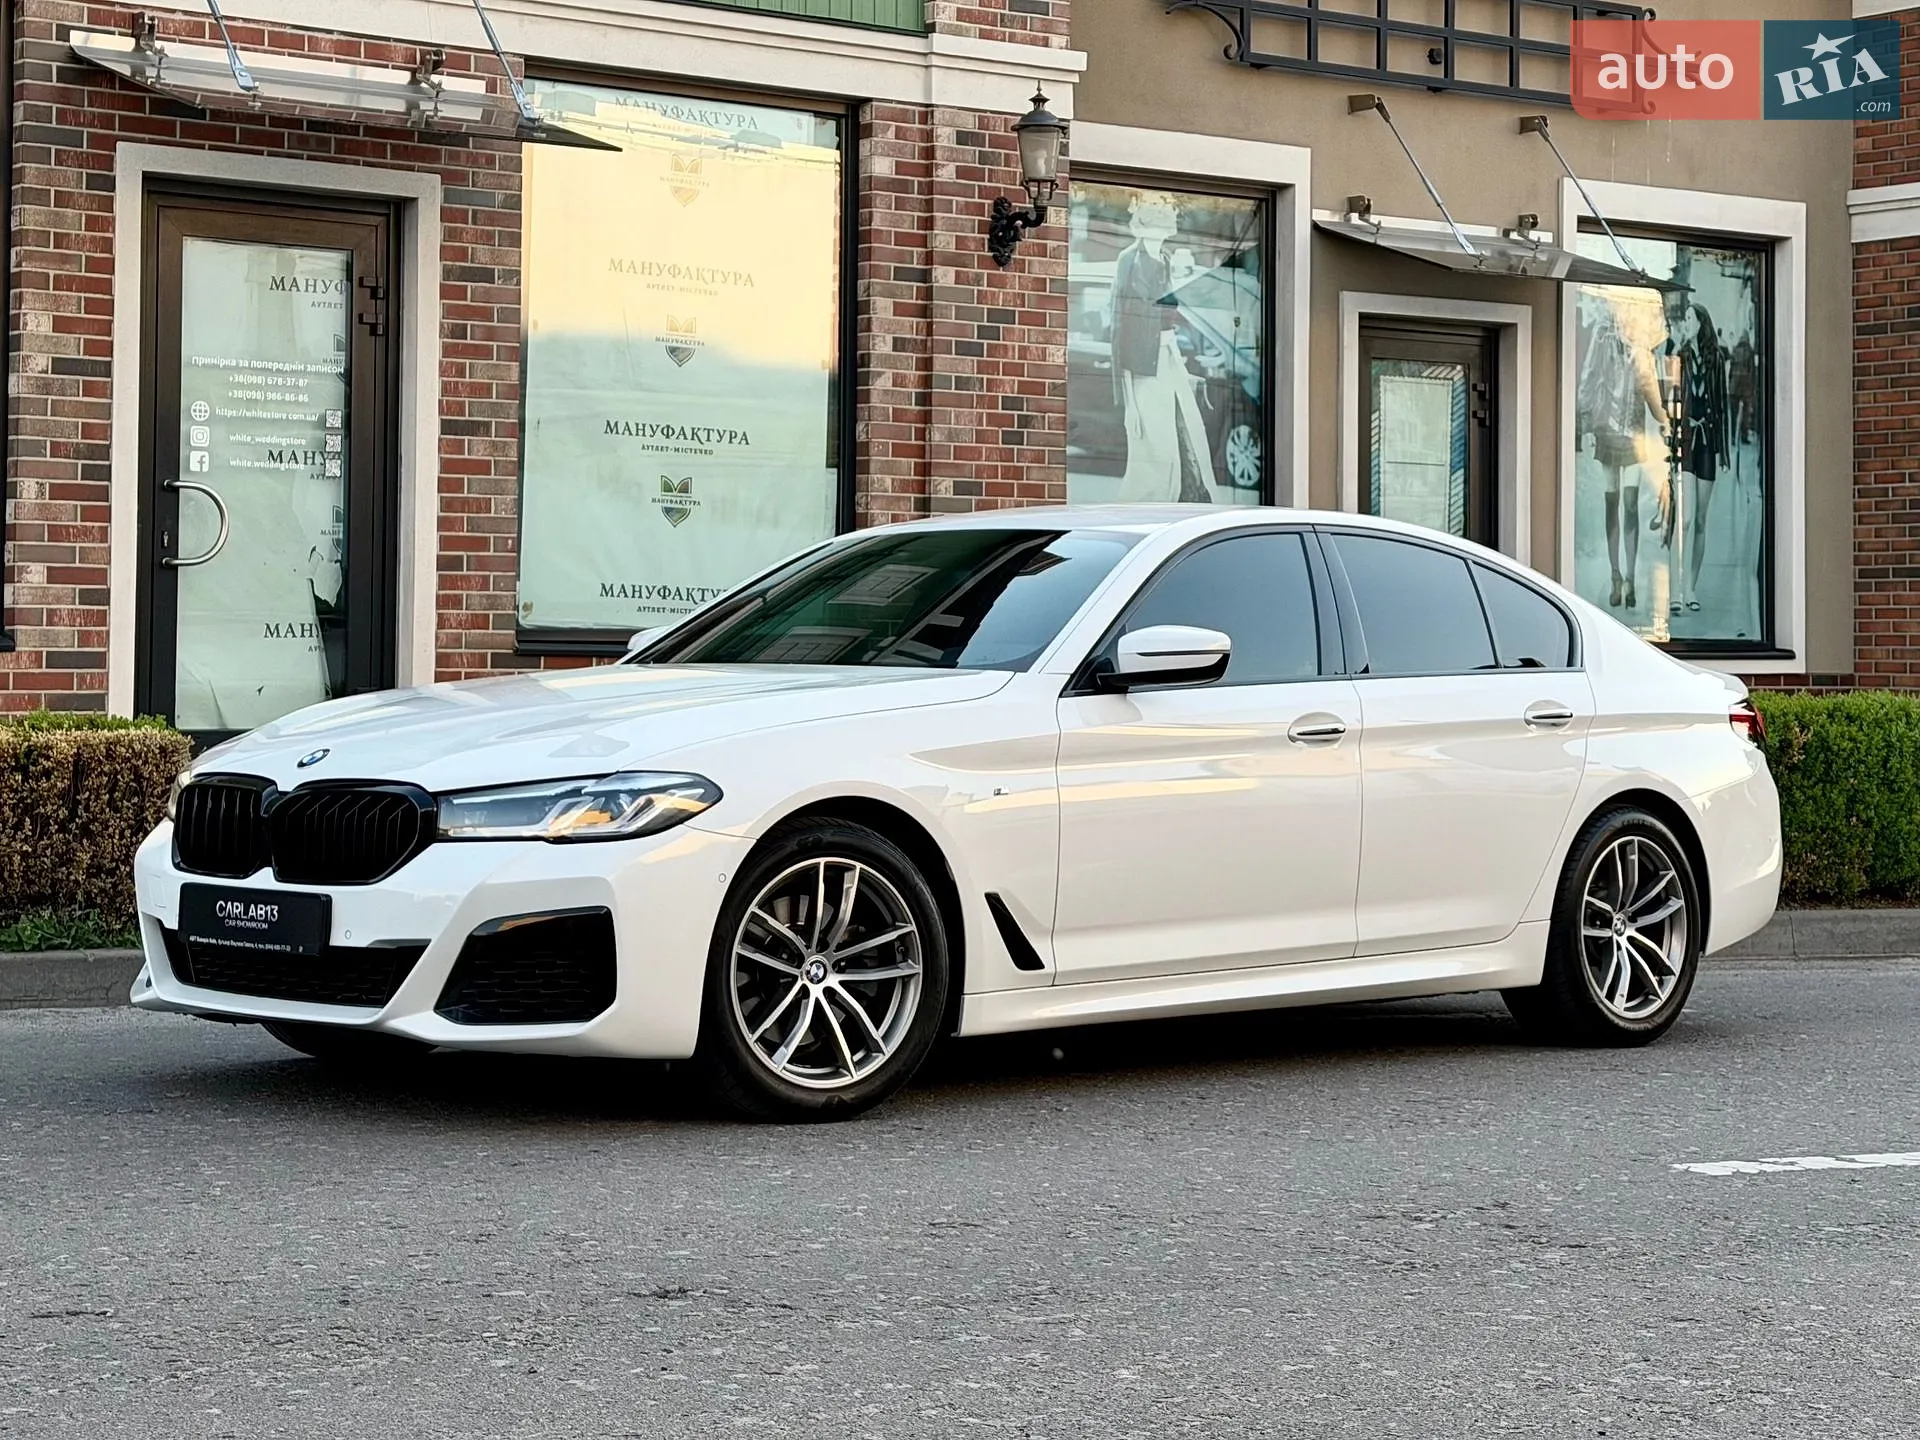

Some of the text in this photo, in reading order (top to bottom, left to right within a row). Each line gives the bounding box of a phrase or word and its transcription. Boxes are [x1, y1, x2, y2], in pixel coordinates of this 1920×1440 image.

[615, 96, 759, 130] МАНУФАКТУРА
[607, 257, 755, 288] МАНУФАКТУРА
[238, 359, 249, 367] за
[604, 420, 750, 445] МАНУФАКТУРА
[268, 449, 341, 466] МАНУ
[600, 582, 729, 605] МАНУФАКТУ
[637, 605, 696, 615] АУТЛЕТ-МІСТ
[216, 900, 279, 922] CARLAB13
[224, 918, 236, 927] CAR
